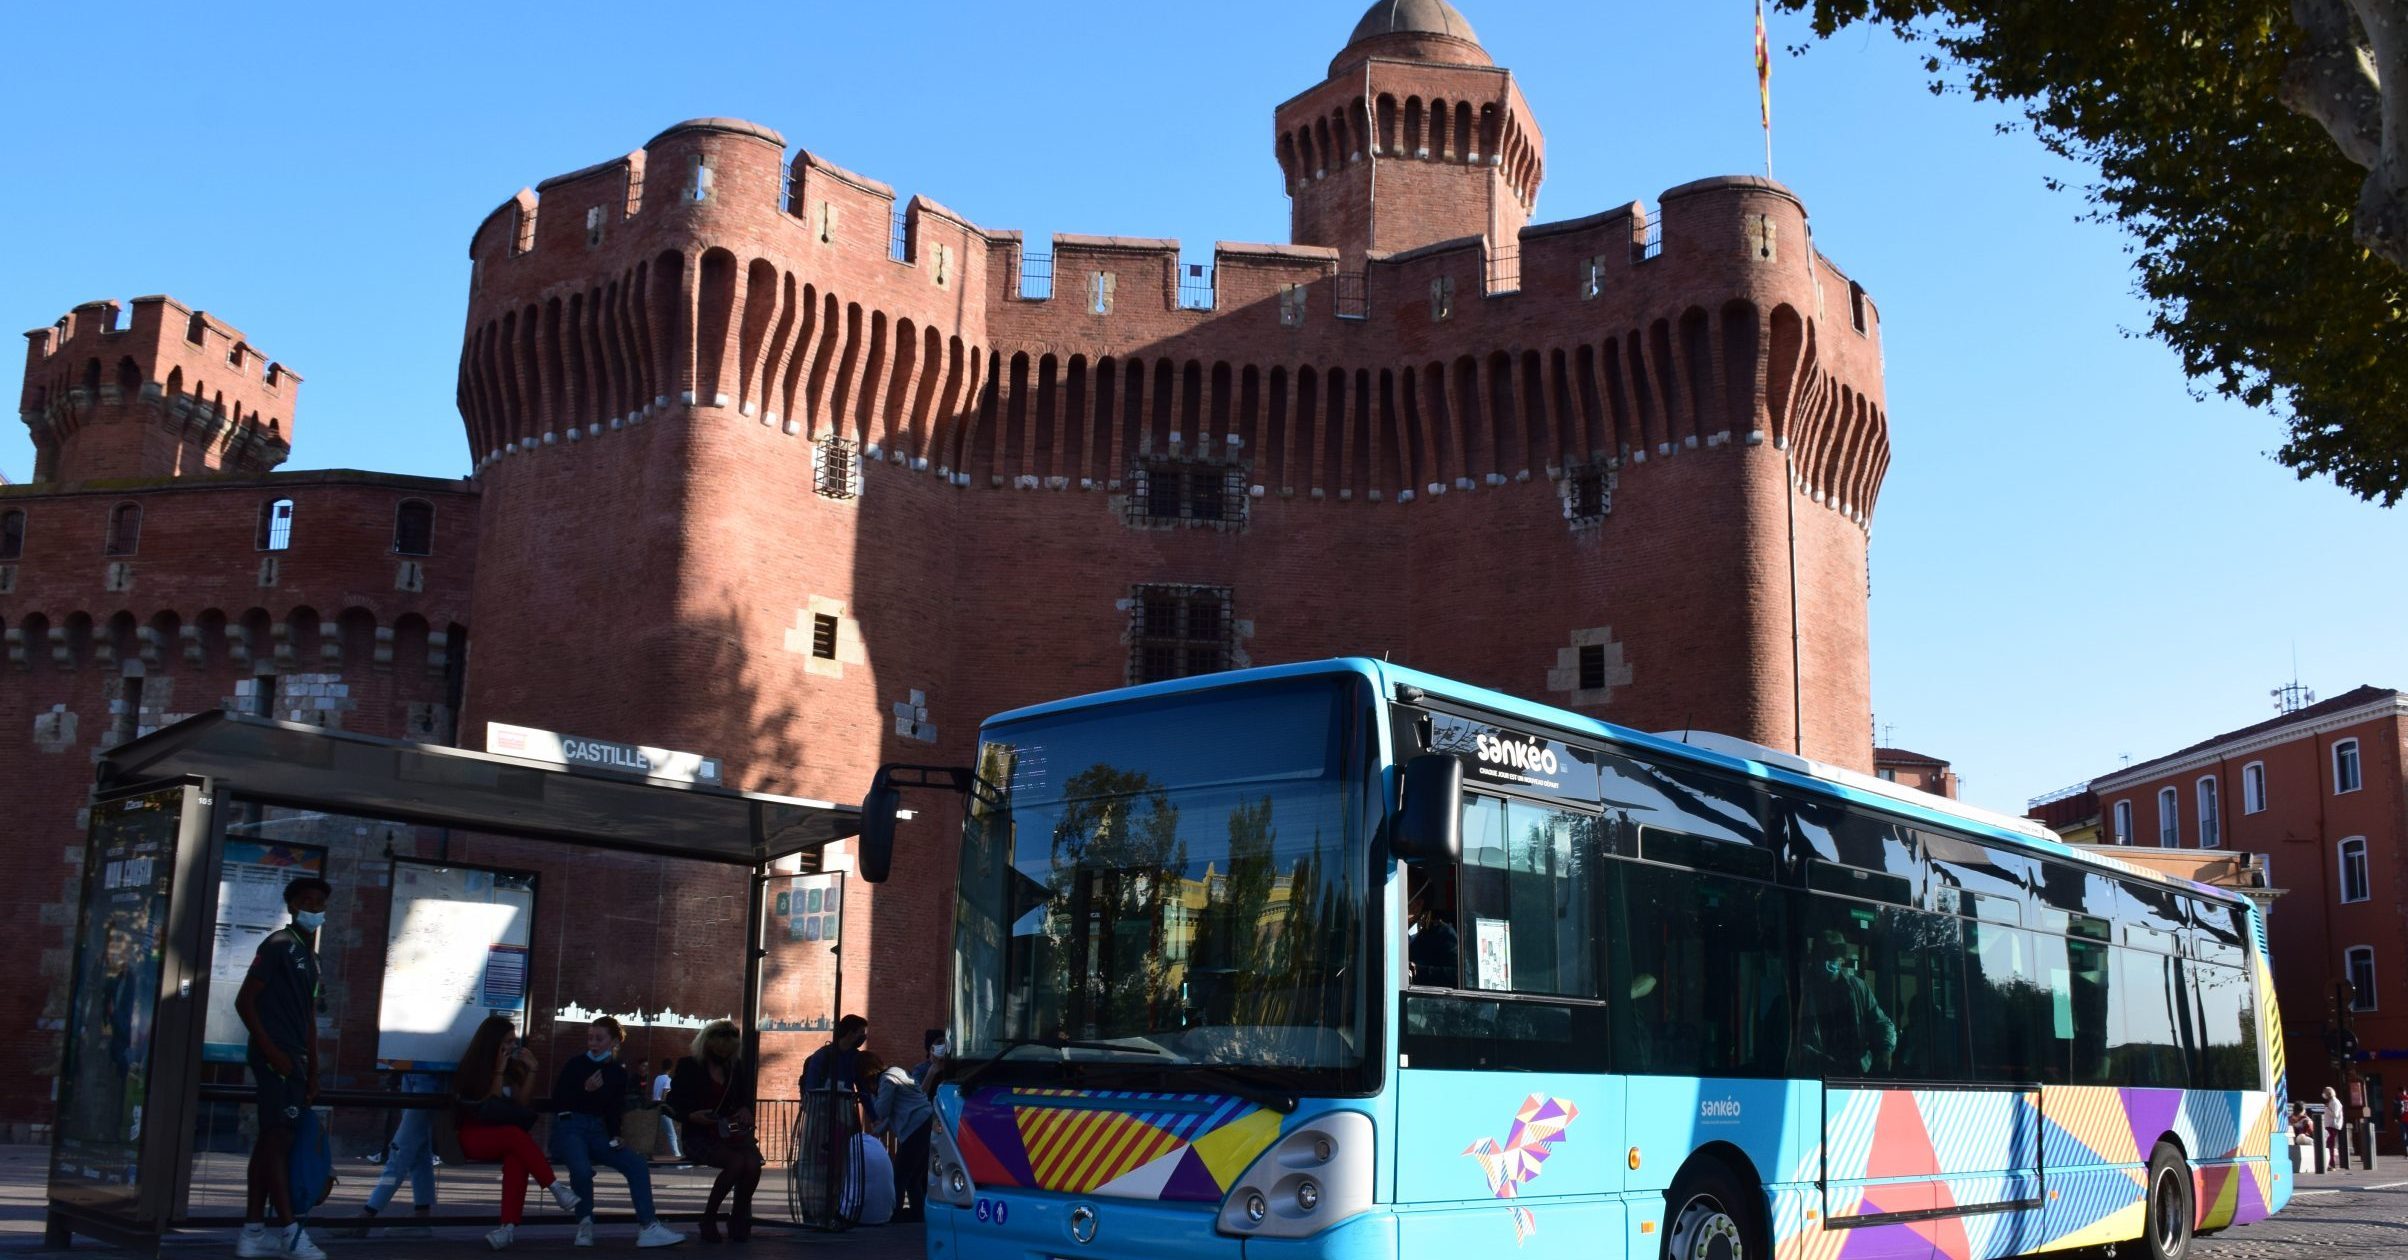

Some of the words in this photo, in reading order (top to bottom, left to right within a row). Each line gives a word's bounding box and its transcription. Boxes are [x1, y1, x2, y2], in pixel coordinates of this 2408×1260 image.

[1477, 734, 1557, 775] sankéo
[198, 797, 213, 806] 105
[1701, 1095, 1741, 1117] sankéo
